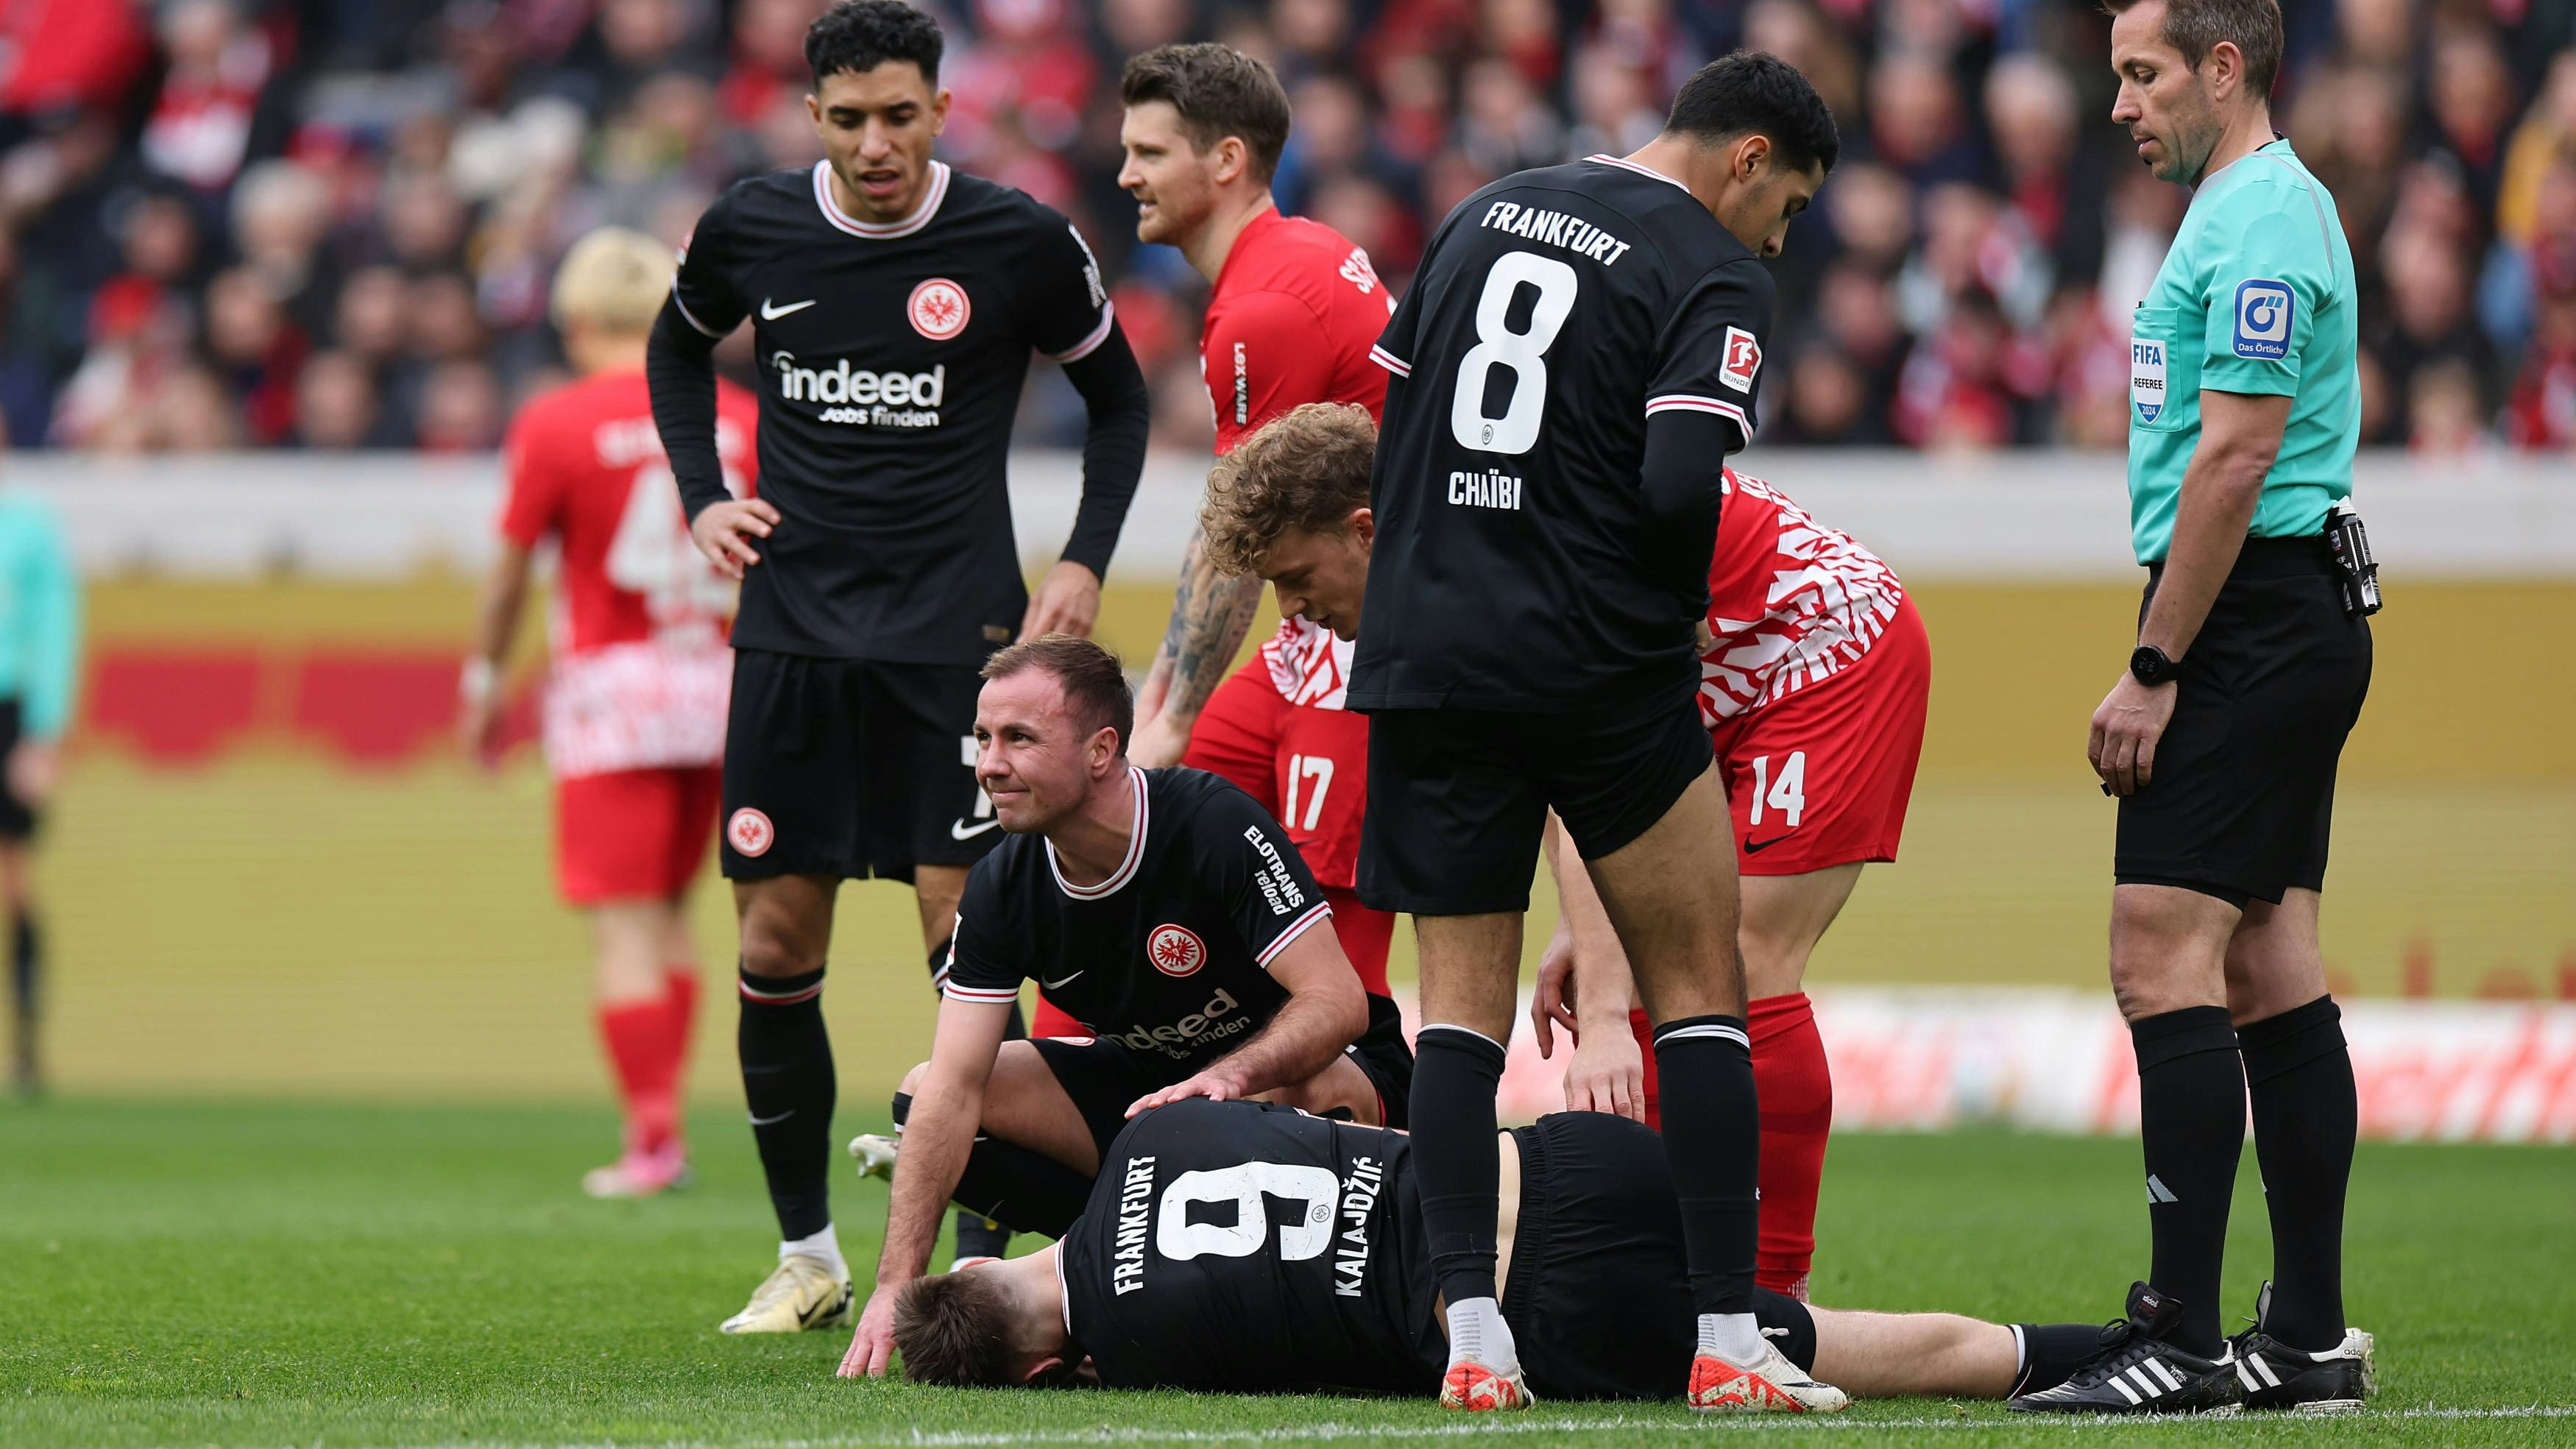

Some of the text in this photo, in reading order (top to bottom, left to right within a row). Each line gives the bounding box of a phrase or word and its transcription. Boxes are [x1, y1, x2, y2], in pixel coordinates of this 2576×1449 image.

[1481, 201, 1631, 266] FRANKFURT
[772, 350, 945, 408] indeed
[1451, 250, 1578, 455] 8
[2133, 344, 2162, 366] FIFA
[2238, 342, 2284, 355] Das Örtliche
[2134, 377, 2163, 390] REFEREE
[2142, 405, 2156, 416] 2024
[871, 405, 939, 427] finden
[1448, 468, 1521, 510] CHAÏBI
[1285, 753, 1334, 831] 17
[1750, 751, 1805, 826] 14
[1243, 825, 1304, 907] ELOTRANS
[1254, 869, 1292, 915] reload
[1100, 988, 1238, 1050] ndeed
[1114, 1156, 1156, 1296] FRANKFURT
[1156, 1161, 1340, 1261] 9
[1334, 1156, 1383, 1297] KALAJDŽIĆ
